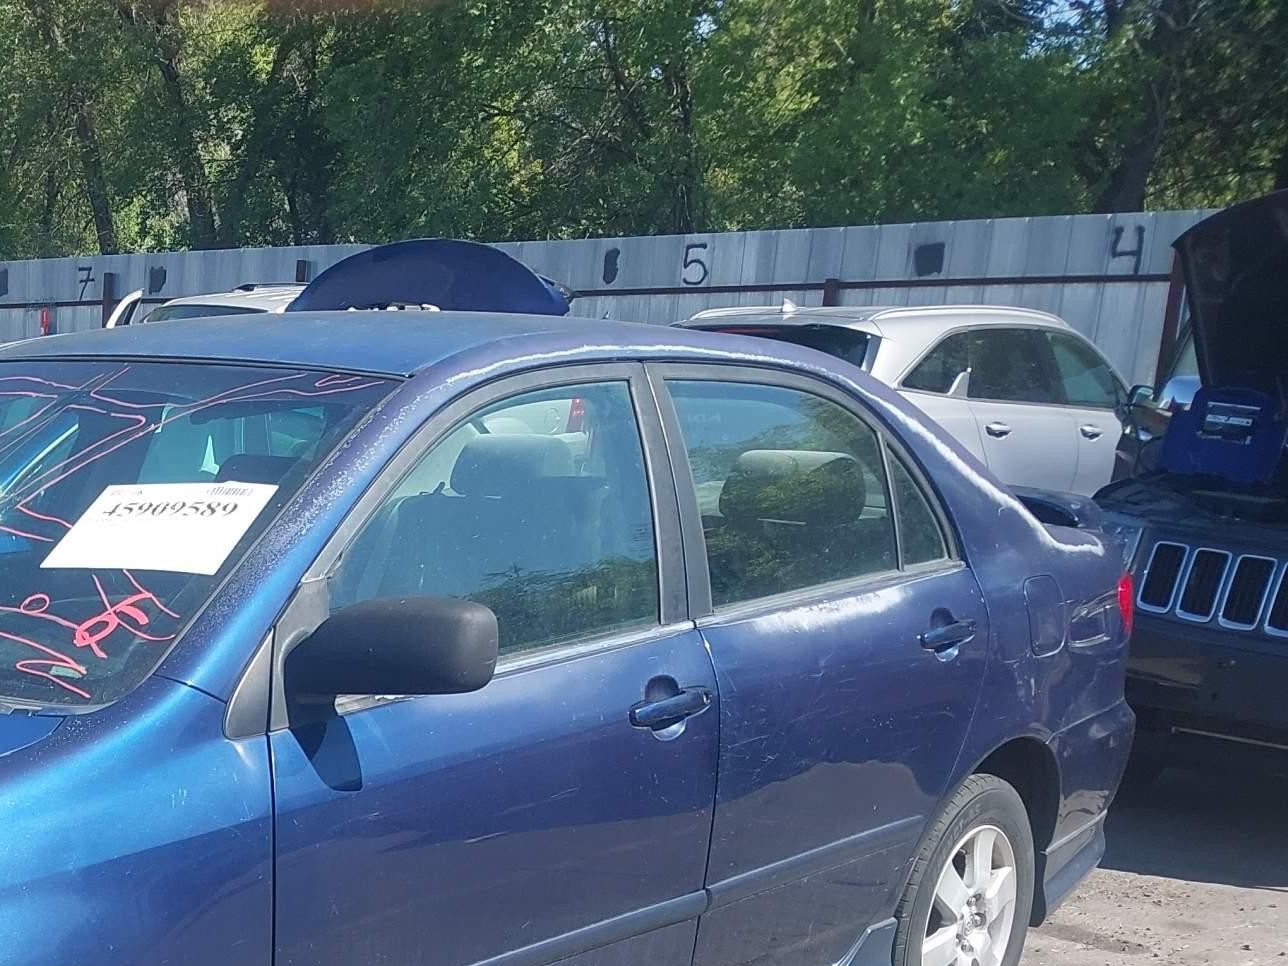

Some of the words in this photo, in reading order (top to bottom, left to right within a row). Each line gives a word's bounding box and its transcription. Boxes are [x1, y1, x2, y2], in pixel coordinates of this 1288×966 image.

[682, 244, 707, 285] 5
[1113, 226, 1145, 274] 4
[78, 267, 95, 301] 7
[102, 500, 238, 517] 45909589
